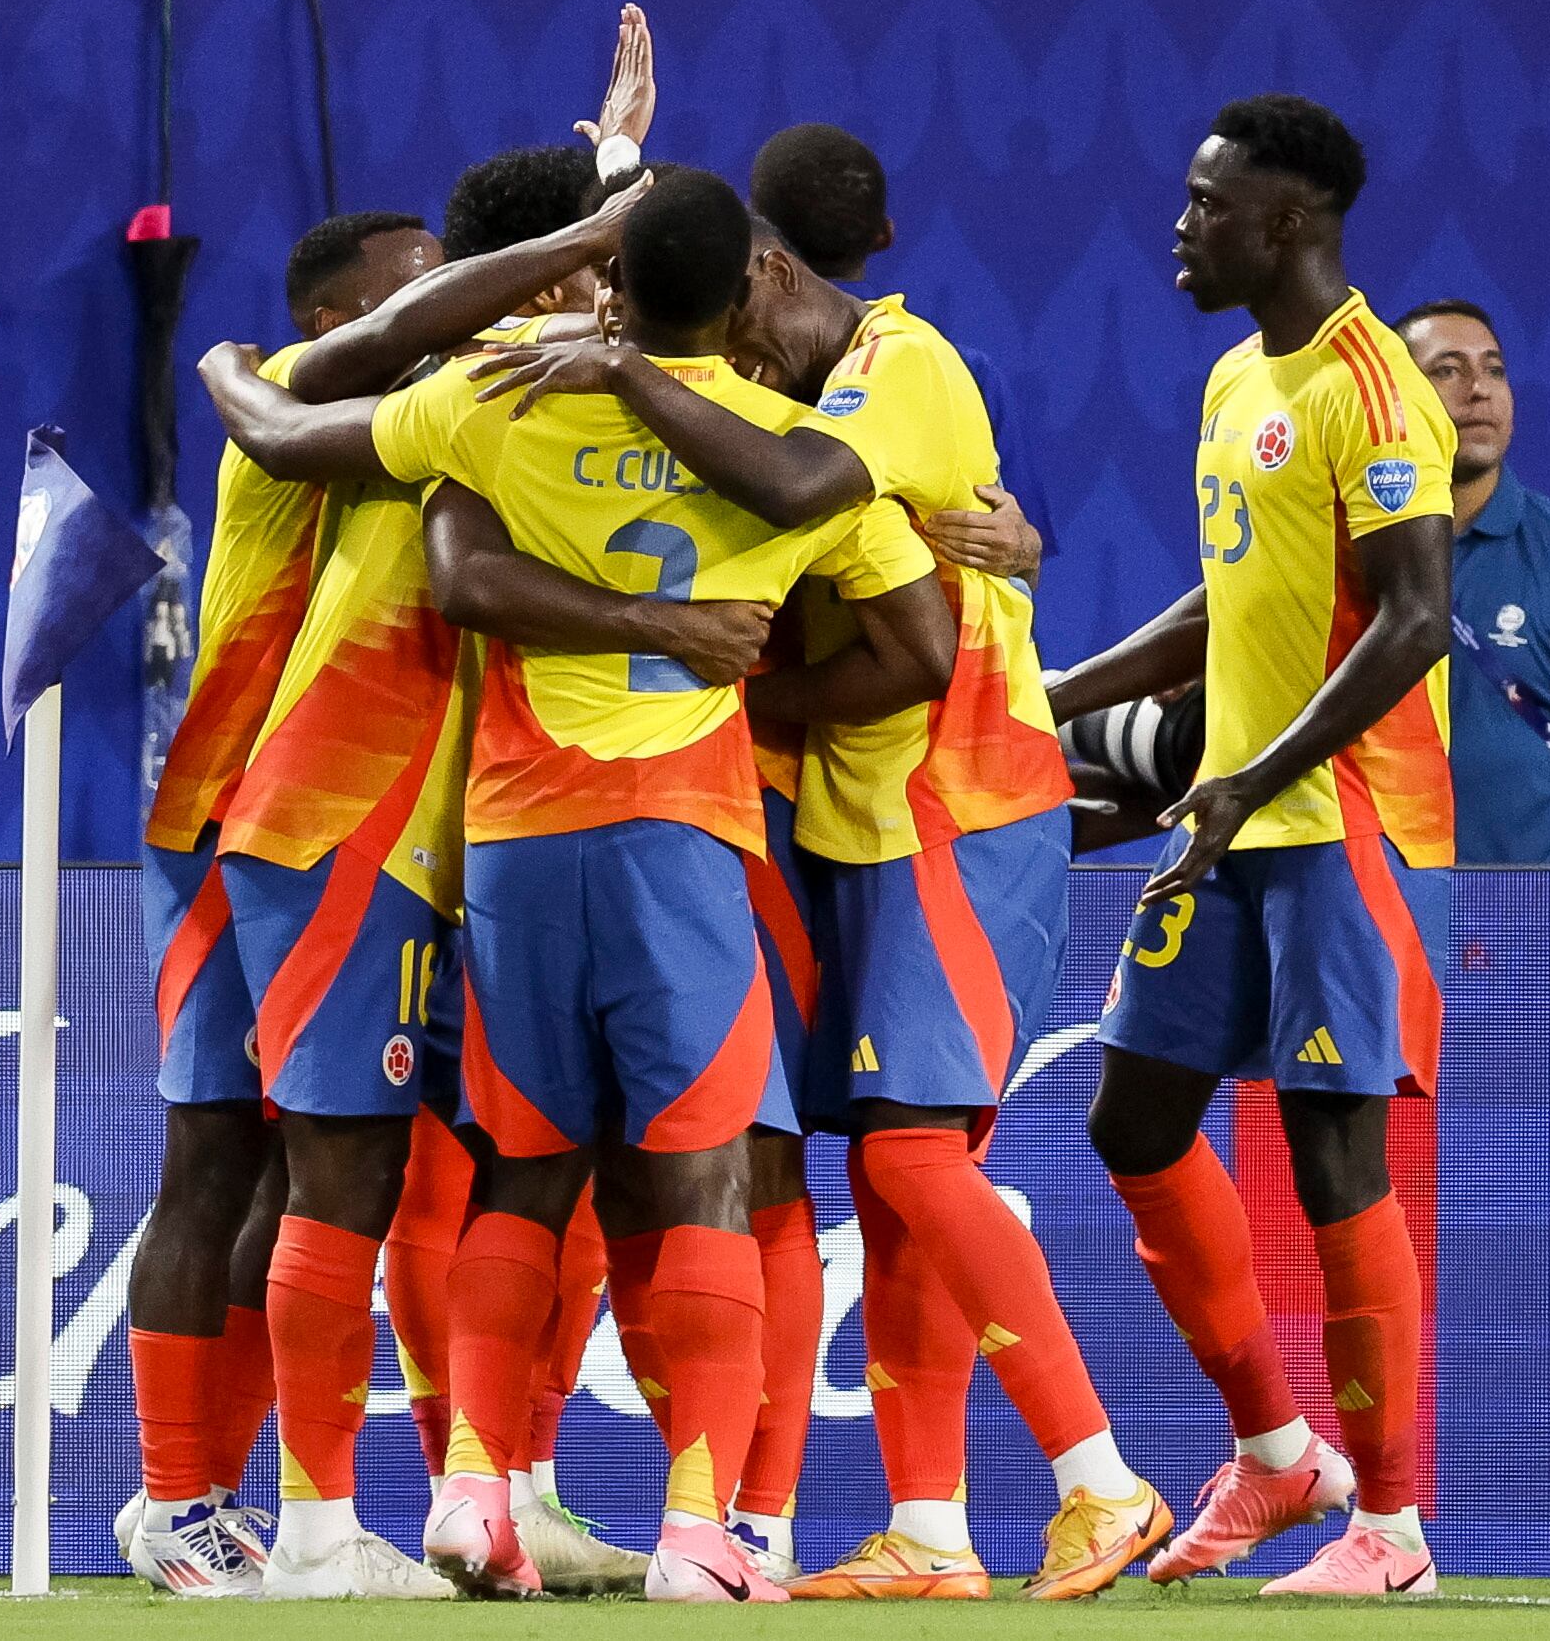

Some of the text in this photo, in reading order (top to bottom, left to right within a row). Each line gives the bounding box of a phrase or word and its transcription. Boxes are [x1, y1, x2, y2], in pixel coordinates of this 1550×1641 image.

[573, 446, 709, 495] C. CUE
[1372, 472, 1411, 485] VIBRA
[1201, 474, 1253, 564] 23
[1121, 892, 1196, 968] 3
